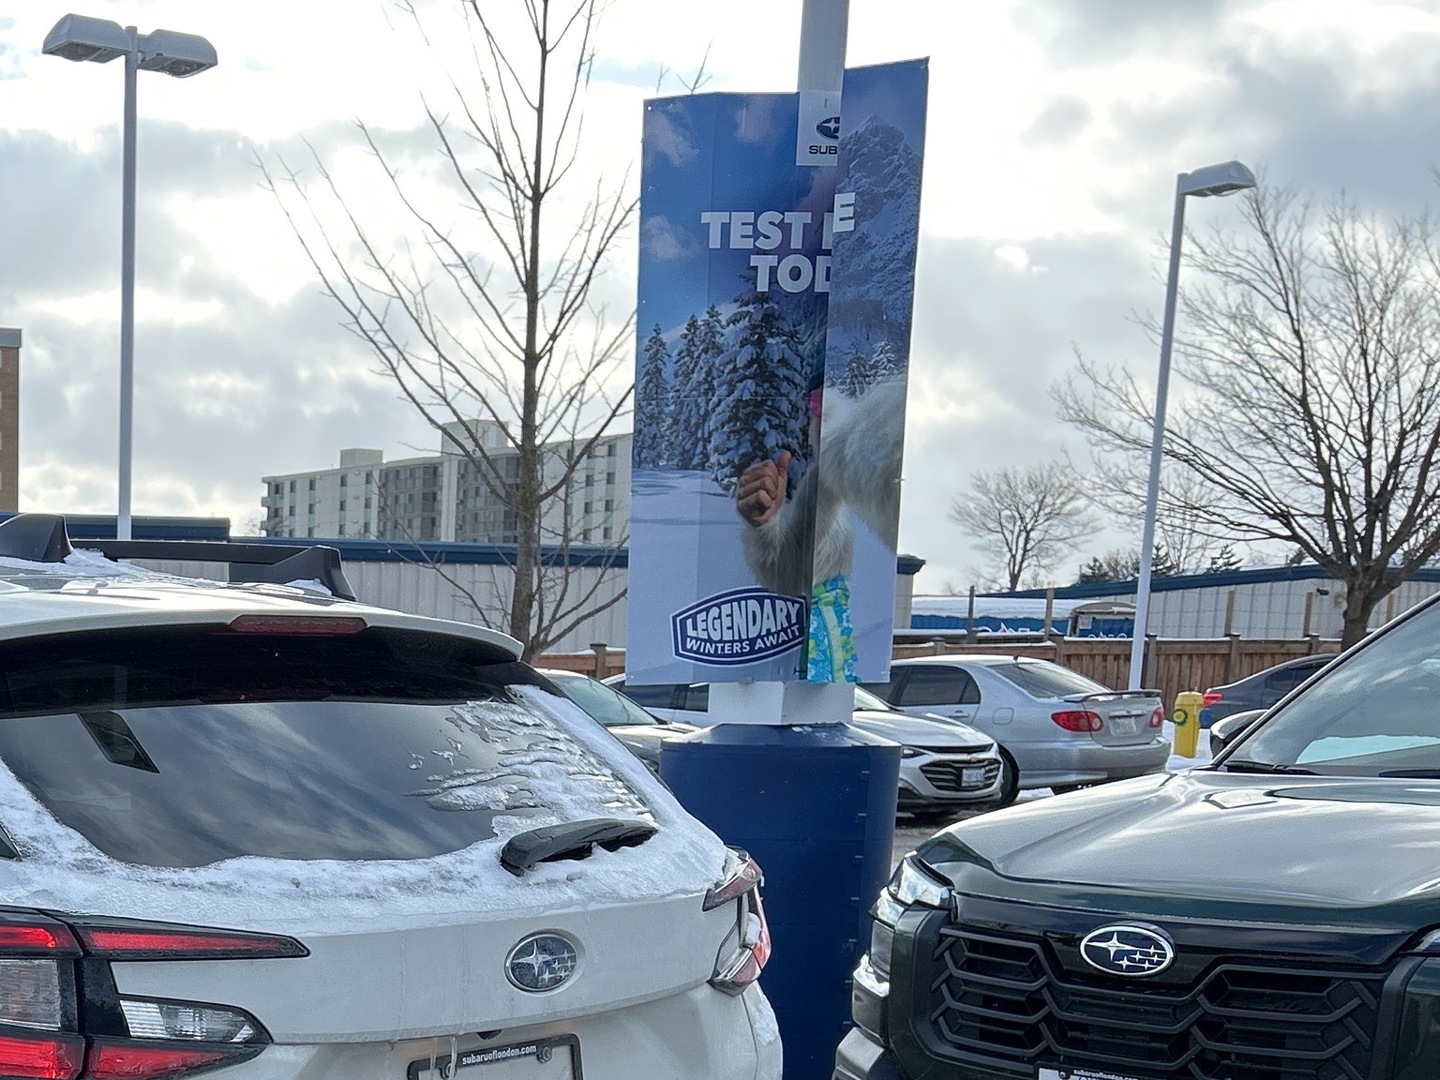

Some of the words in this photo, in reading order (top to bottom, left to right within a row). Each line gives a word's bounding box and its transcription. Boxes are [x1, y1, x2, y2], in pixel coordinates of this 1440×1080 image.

[701, 211, 812, 250] TEST
[686, 599, 801, 641] LEGENDARY
[686, 636, 750, 655] WINTERS
[754, 625, 801, 650] AWAIT
[462, 1045, 537, 1065] subaruoflondon.com
